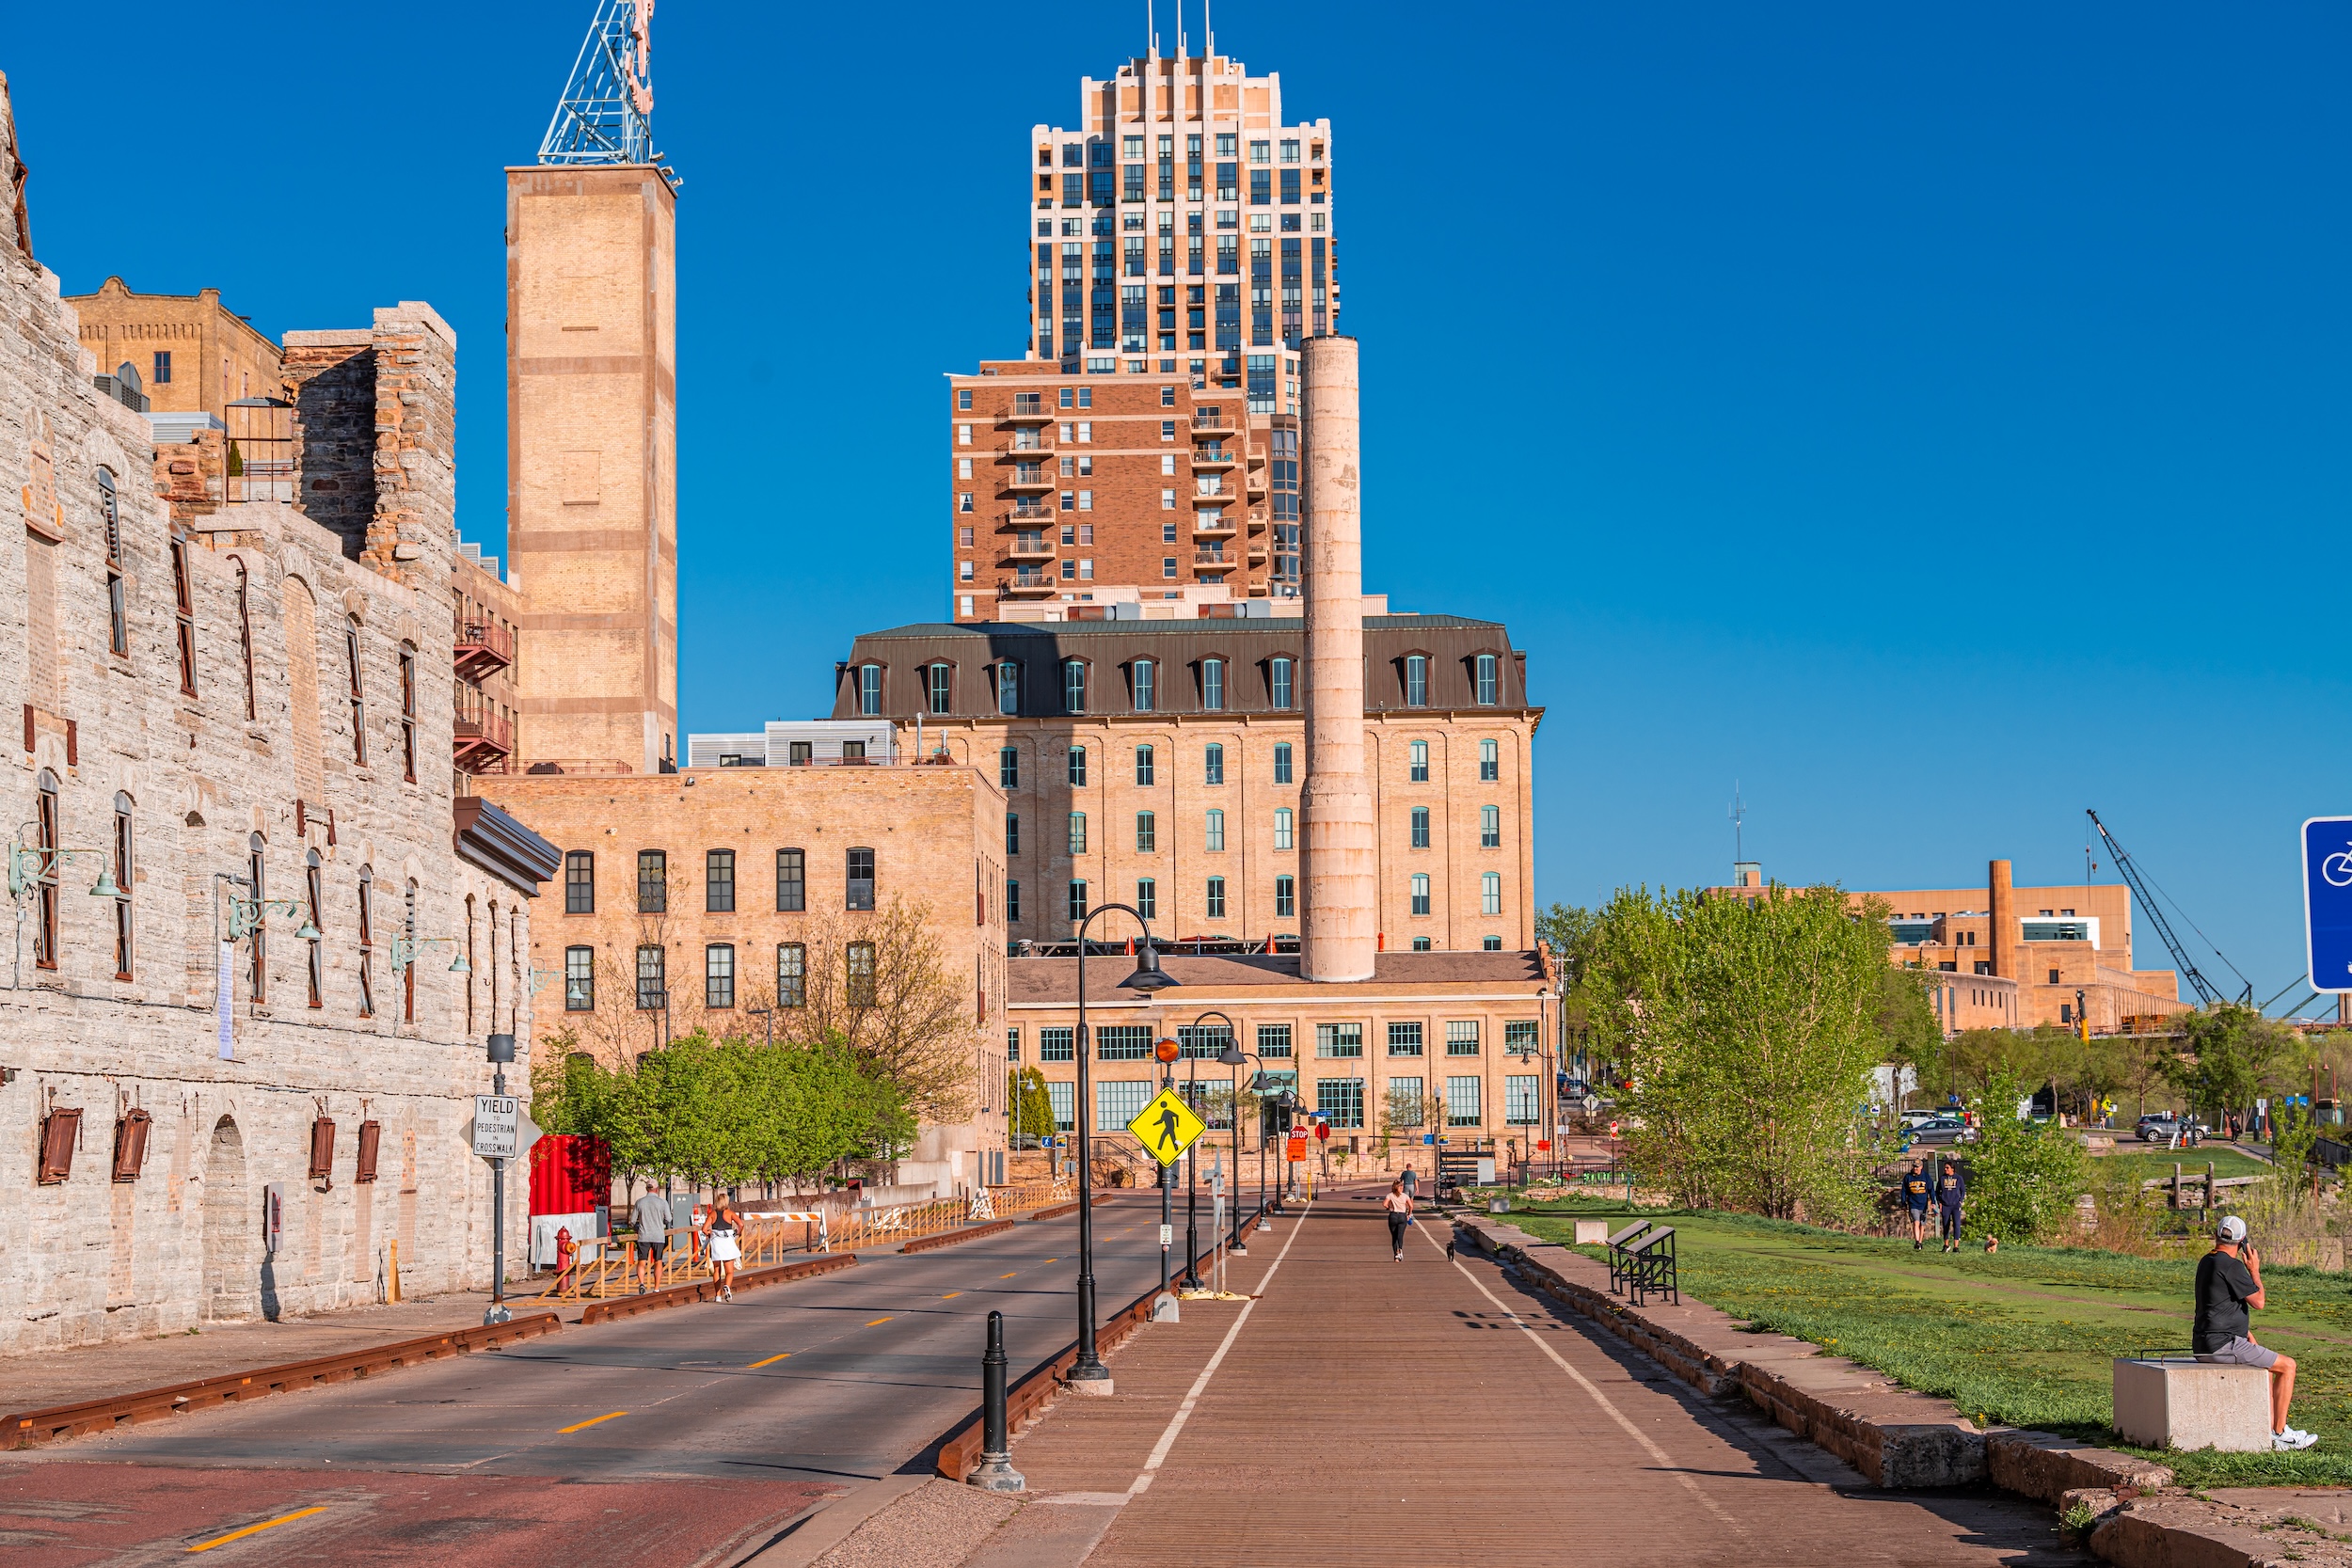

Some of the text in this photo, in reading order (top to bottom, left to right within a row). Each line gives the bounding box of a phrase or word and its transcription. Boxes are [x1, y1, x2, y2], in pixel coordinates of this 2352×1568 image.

[481, 1099, 514, 1114] YIELD
[477, 1123, 515, 1133] PEDESTRIAN
[1291, 1130, 1308, 1138] STOP
[476, 1143, 513, 1153] CROSSWALK
